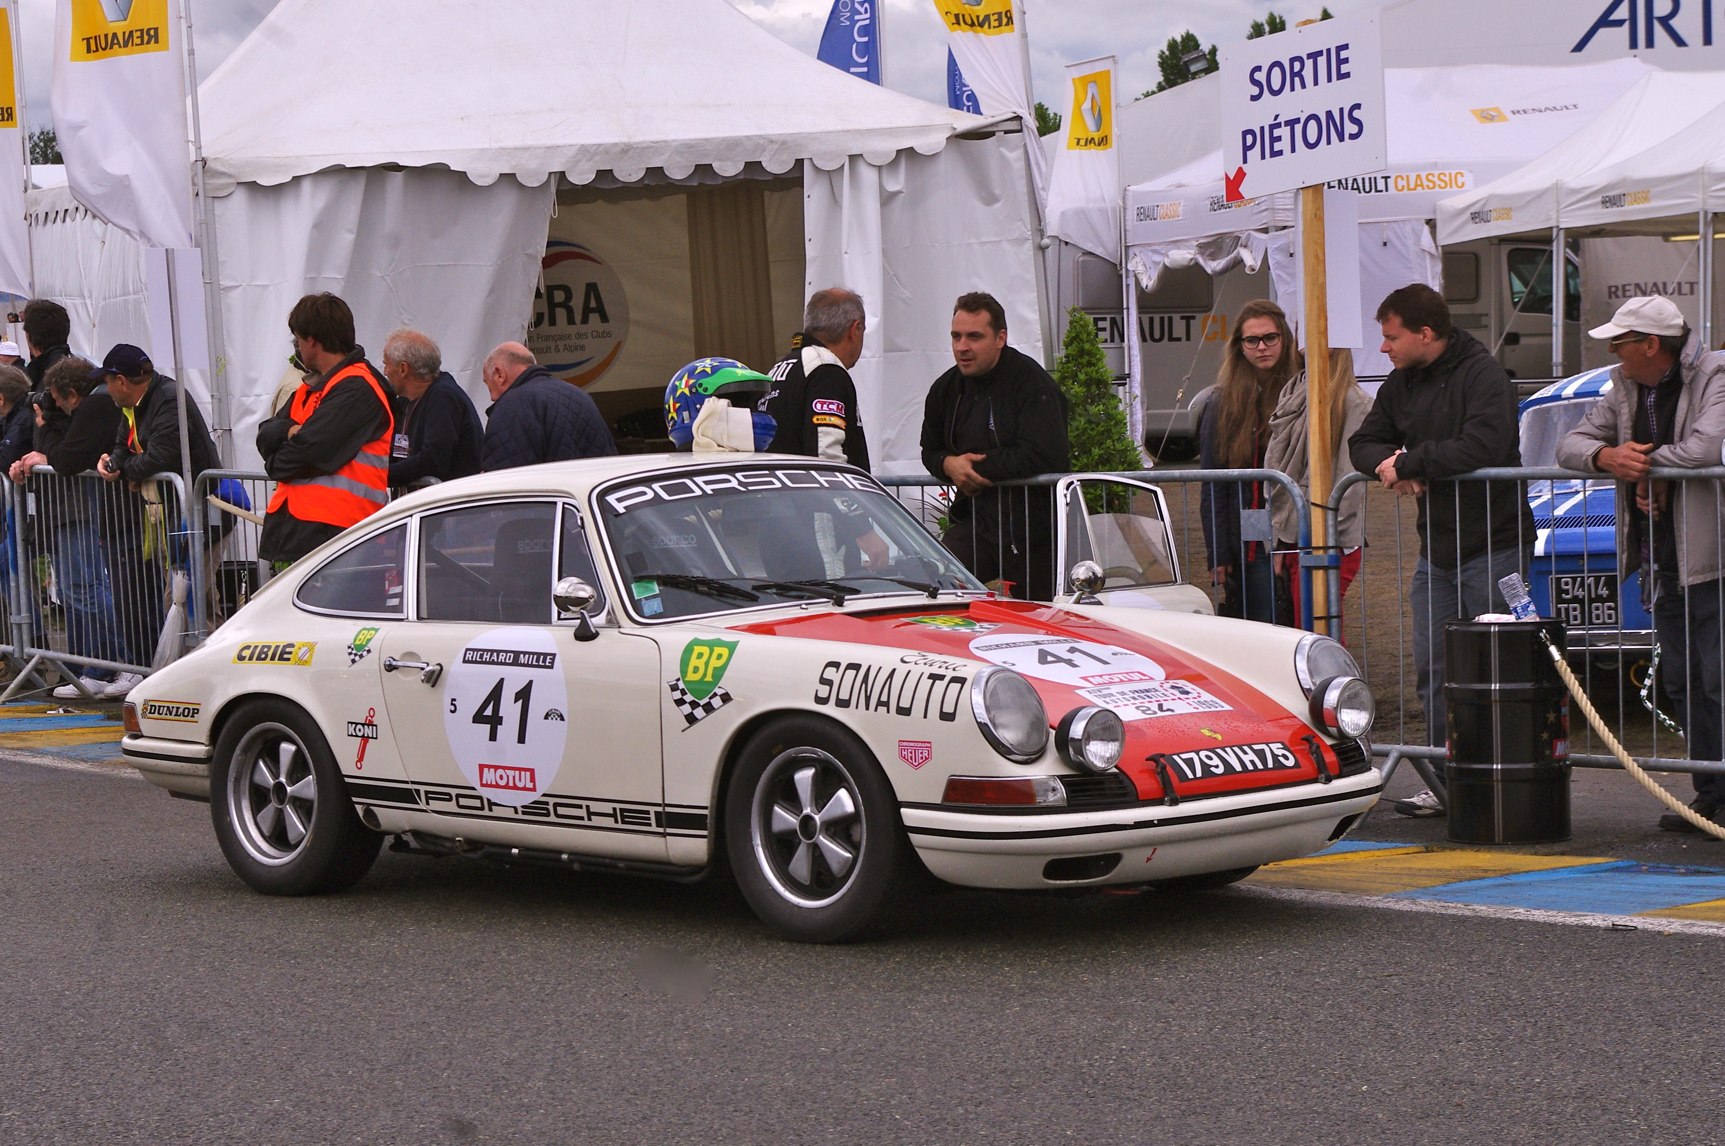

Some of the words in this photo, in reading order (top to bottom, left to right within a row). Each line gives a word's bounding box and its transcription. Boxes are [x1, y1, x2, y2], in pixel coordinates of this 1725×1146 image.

[1249, 43, 1351, 102] SORTIE
[1510, 104, 1580, 116] RENAULT
[1241, 103, 1364, 165] PIÉTONS
[1323, 176, 1391, 194] ENAULT
[1394, 171, 1465, 192] CLASSIC
[1601, 193, 1626, 209] RENAULT
[1136, 205, 1159, 222] RENAULT
[1470, 209, 1492, 224] RENAULT
[1607, 281, 1699, 300] RENAULT
[537, 331, 572, 343] Française
[575, 331, 588, 339] des
[591, 330, 612, 340] Clubs
[563, 344, 586, 354] Alpine
[604, 470, 887, 514] PORSCHE
[1560, 577, 1609, 599] 9414
[1557, 604, 1581, 625] TB
[1591, 603, 1616, 624] 86
[357, 630, 375, 645] BP
[465, 651, 513, 663] RICHARD
[519, 654, 554, 666] MILLE
[684, 645, 729, 682] BP
[1038, 646, 1112, 668] 41
[1087, 671, 1150, 685] MOTUL
[814, 661, 968, 722] SONAUTO
[1094, 691, 1119, 700] TOUR
[1129, 687, 1161, 696] FRANCE
[1102, 692, 1171, 705] AUTOMOBILE
[148, 704, 199, 718] DUNLOP
[450, 698, 458, 714] 5
[472, 677, 534, 744] 41
[1134, 703, 1175, 716] 84
[348, 723, 377, 738] KONI
[902, 749, 929, 765] HEUER
[482, 767, 534, 788] MOTUL
